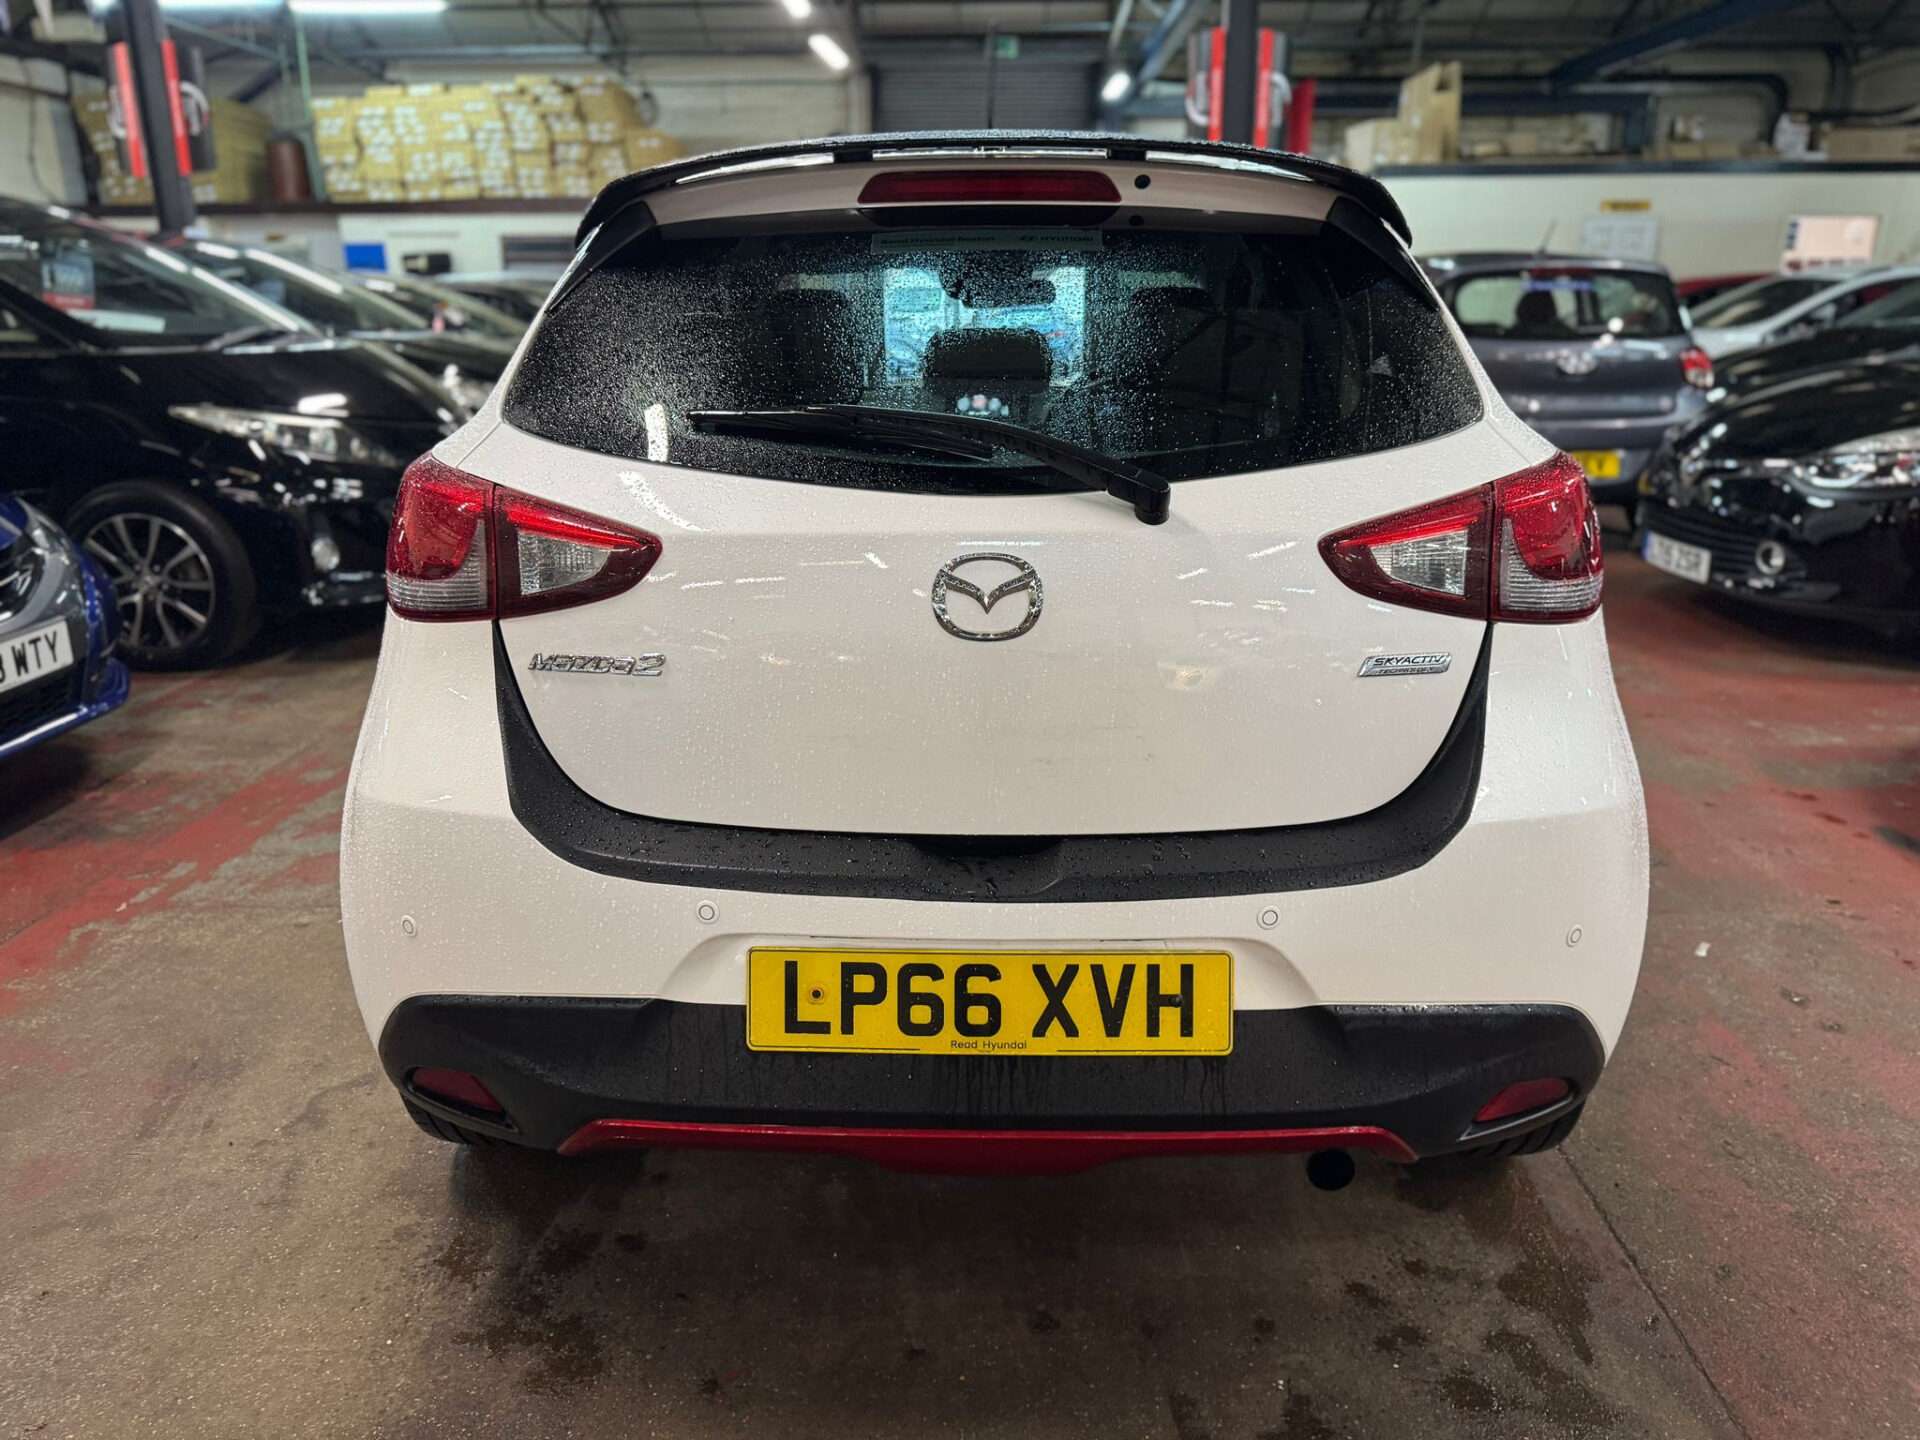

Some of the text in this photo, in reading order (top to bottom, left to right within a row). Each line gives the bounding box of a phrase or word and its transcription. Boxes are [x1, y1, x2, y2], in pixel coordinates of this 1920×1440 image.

[11, 630, 58, 677] WTY
[1373, 655, 1446, 667] SKYACTIV
[784, 960, 1194, 1038] LP66 XVH
[950, 1040, 978, 1049] Read
